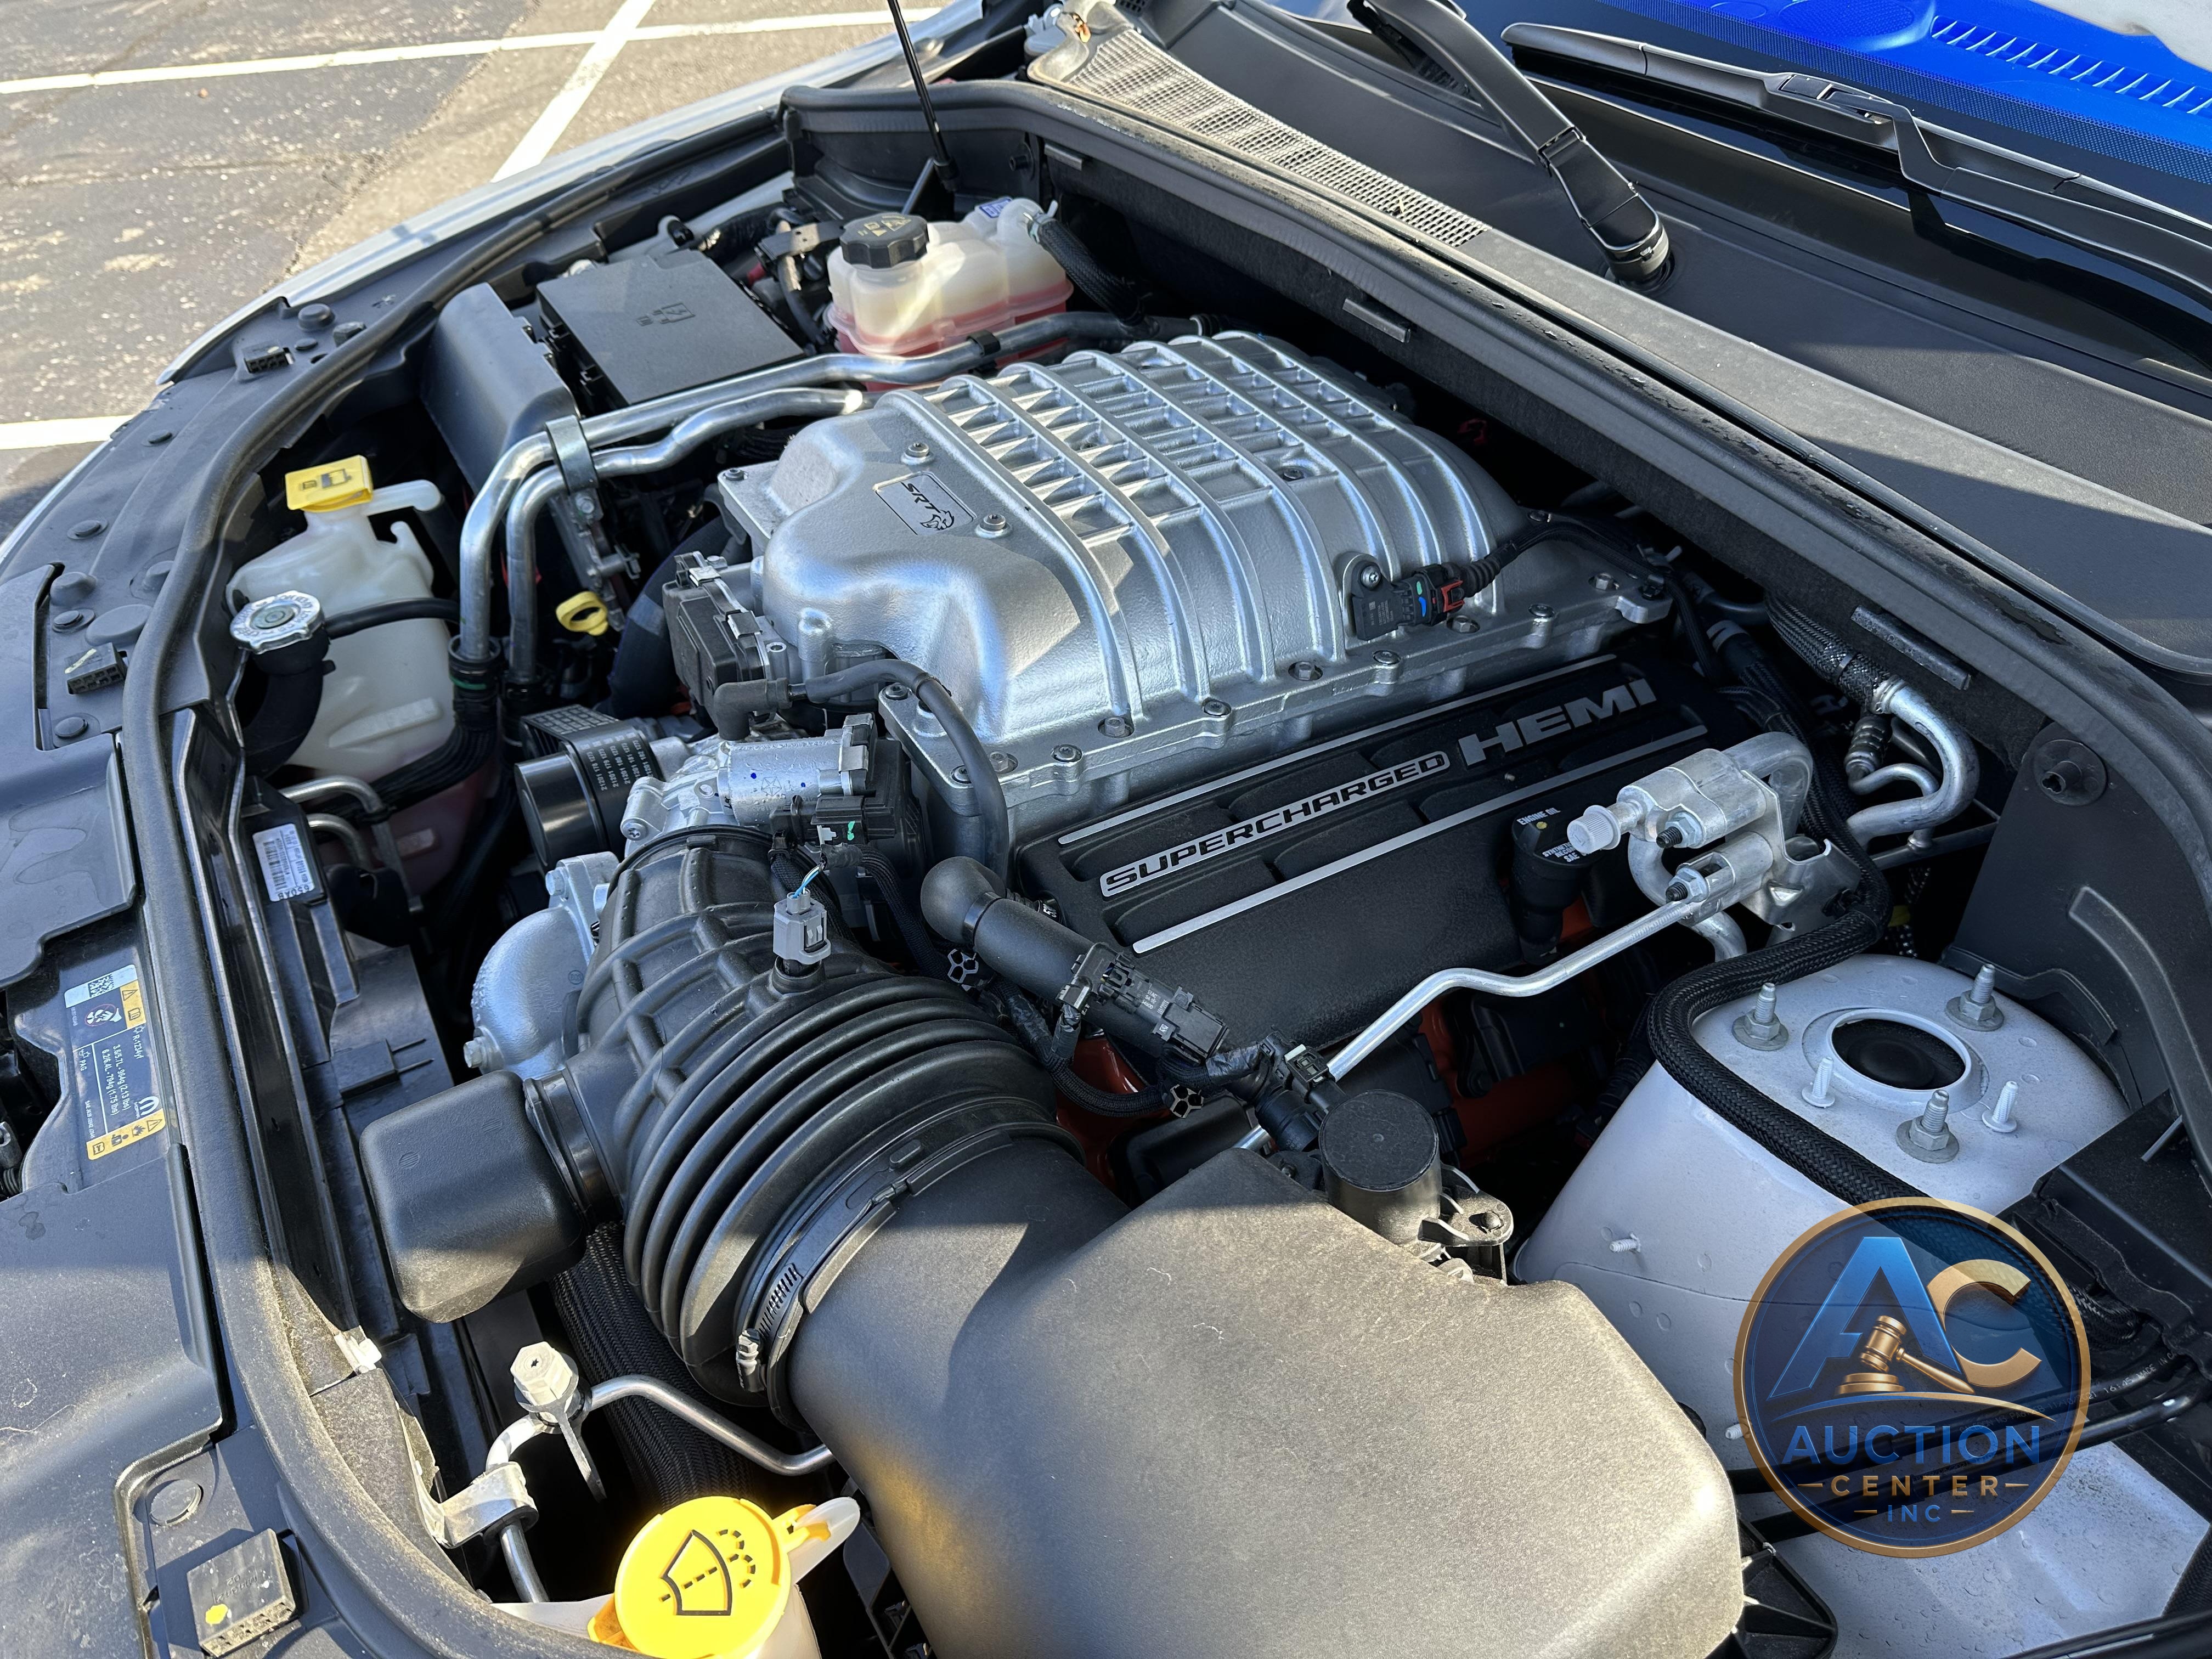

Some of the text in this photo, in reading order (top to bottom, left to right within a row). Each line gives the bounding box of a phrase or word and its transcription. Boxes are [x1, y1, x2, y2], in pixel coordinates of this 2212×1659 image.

[901, 482, 941, 513] SRT
[1458, 679, 1656, 766] HEMI
[631, 764, 641, 780] 1201
[1106, 753, 1447, 891] SUPERCHARGED
[1516, 807, 1561, 826] ENGINE OIL
[1564, 851, 1581, 863] SAE
[113, 1043, 123, 1067] 3.6/5.7L
[132, 1034, 144, 1059] R-1234yf
[79, 1059, 88, 1072] PAG
[101, 1048, 112, 1072] 6.2/6.4L
[110, 1102, 120, 1116] lbs)
[119, 1069, 128, 1085] 964g
[122, 1097, 132, 1111] lbs)
[2136, 1364, 2157, 1380] MADE
